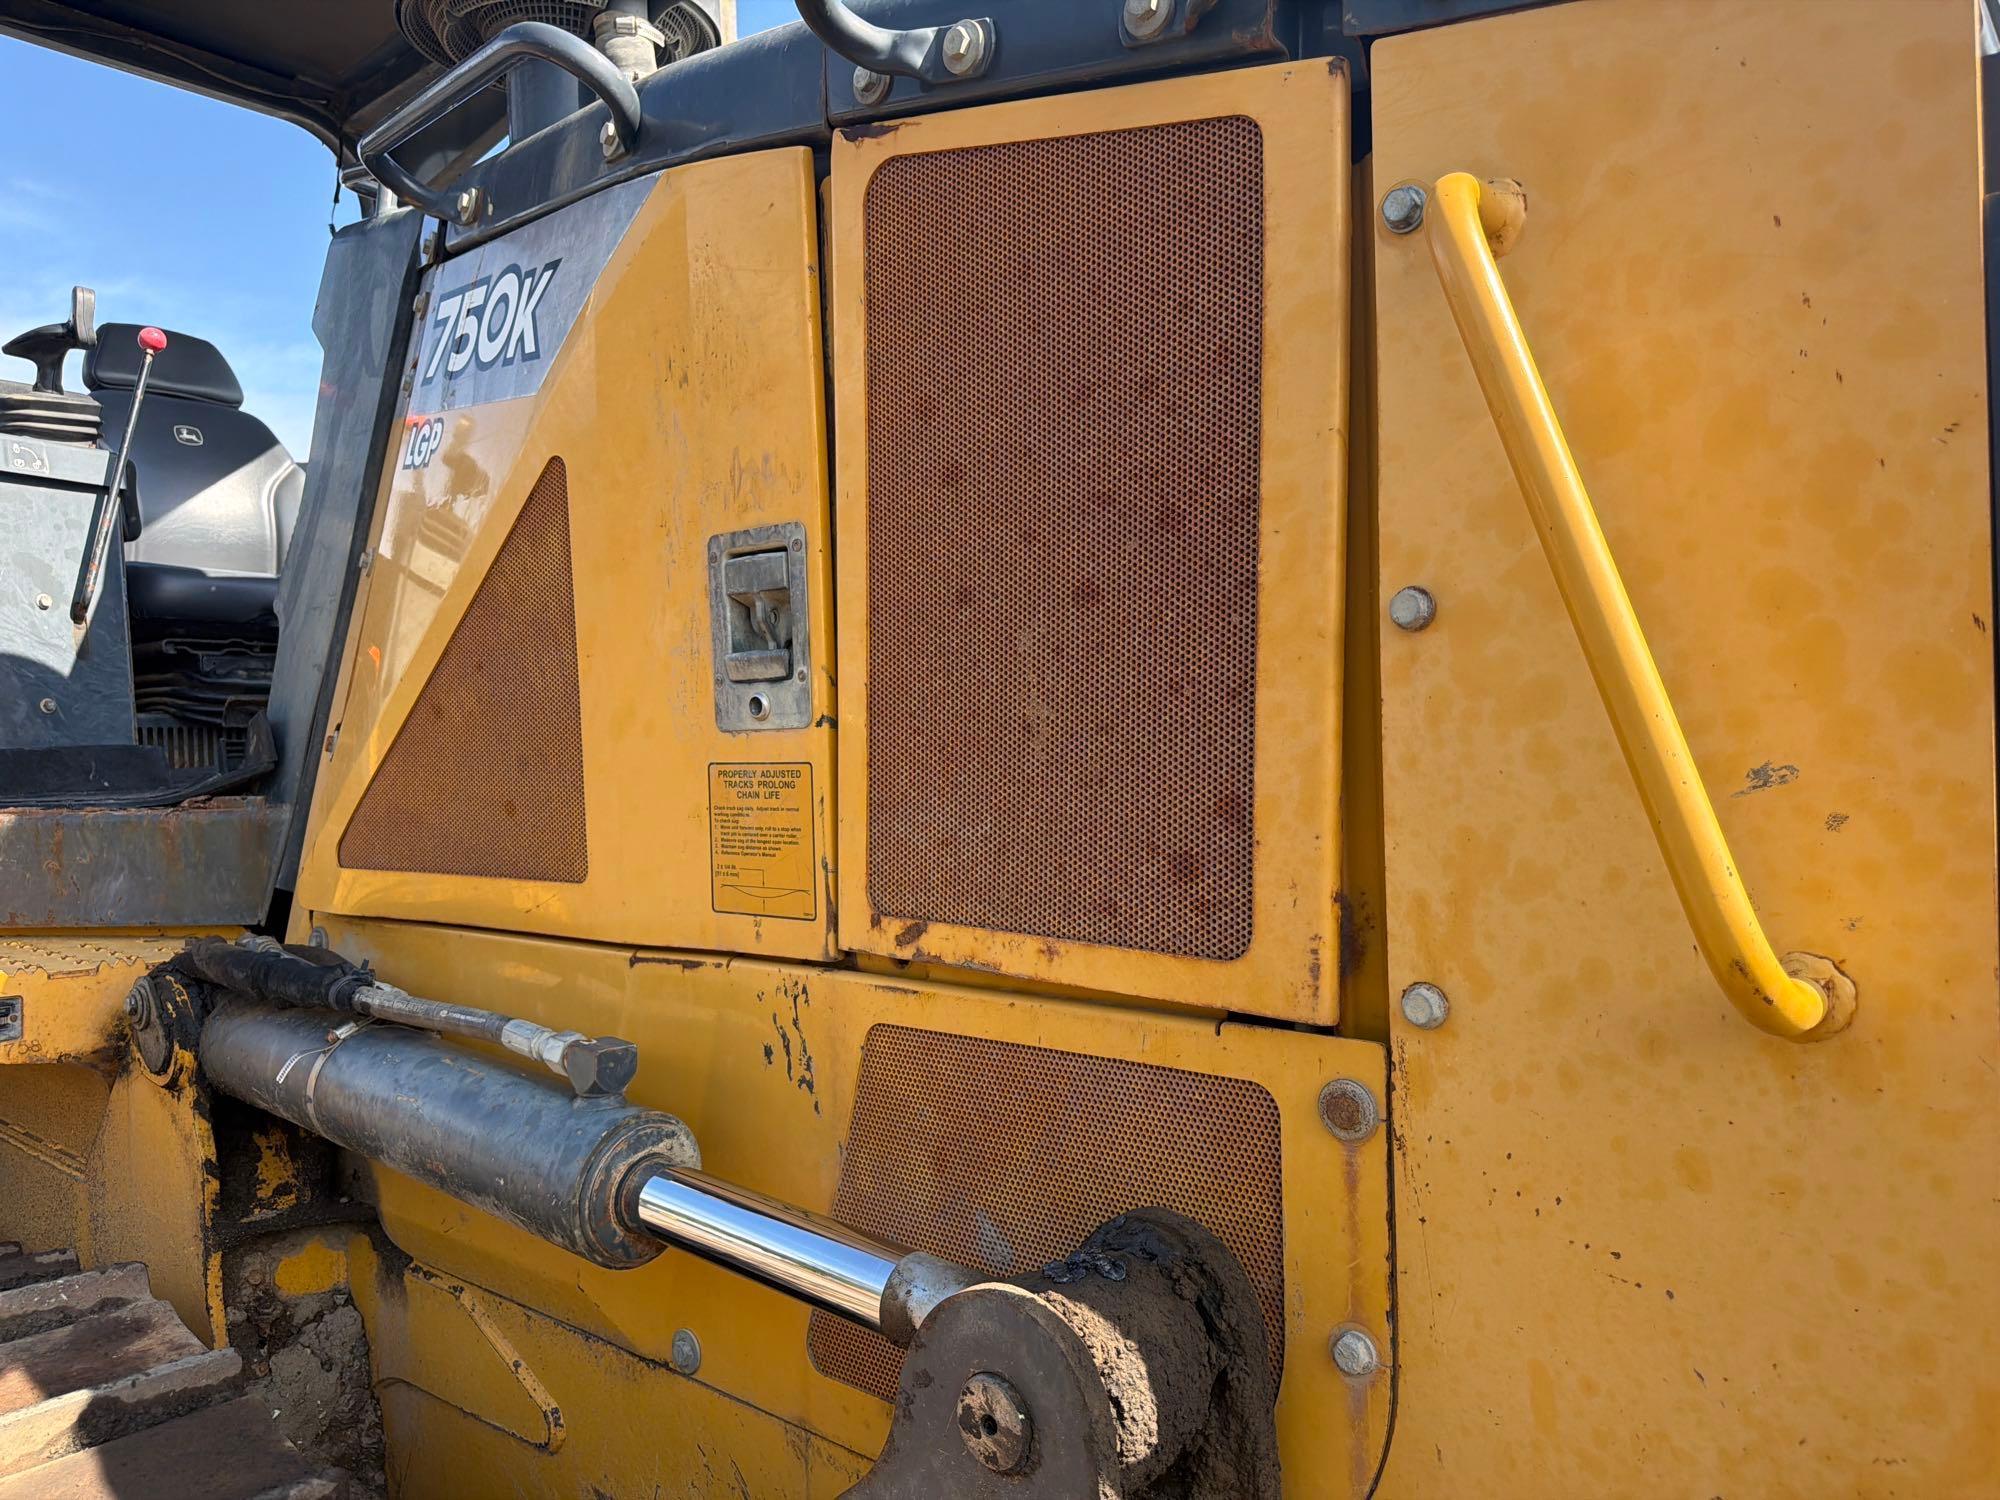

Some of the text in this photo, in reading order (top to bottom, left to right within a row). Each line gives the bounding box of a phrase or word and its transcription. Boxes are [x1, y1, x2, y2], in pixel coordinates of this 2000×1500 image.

[422, 258, 562, 386] 750K
[403, 417, 445, 470] LGP
[718, 770, 801, 779] PROPERLY ADJUSTED
[724, 780, 796, 789] TRACKS PROLONG
[736, 790, 781, 799] CHAIN LIFE
